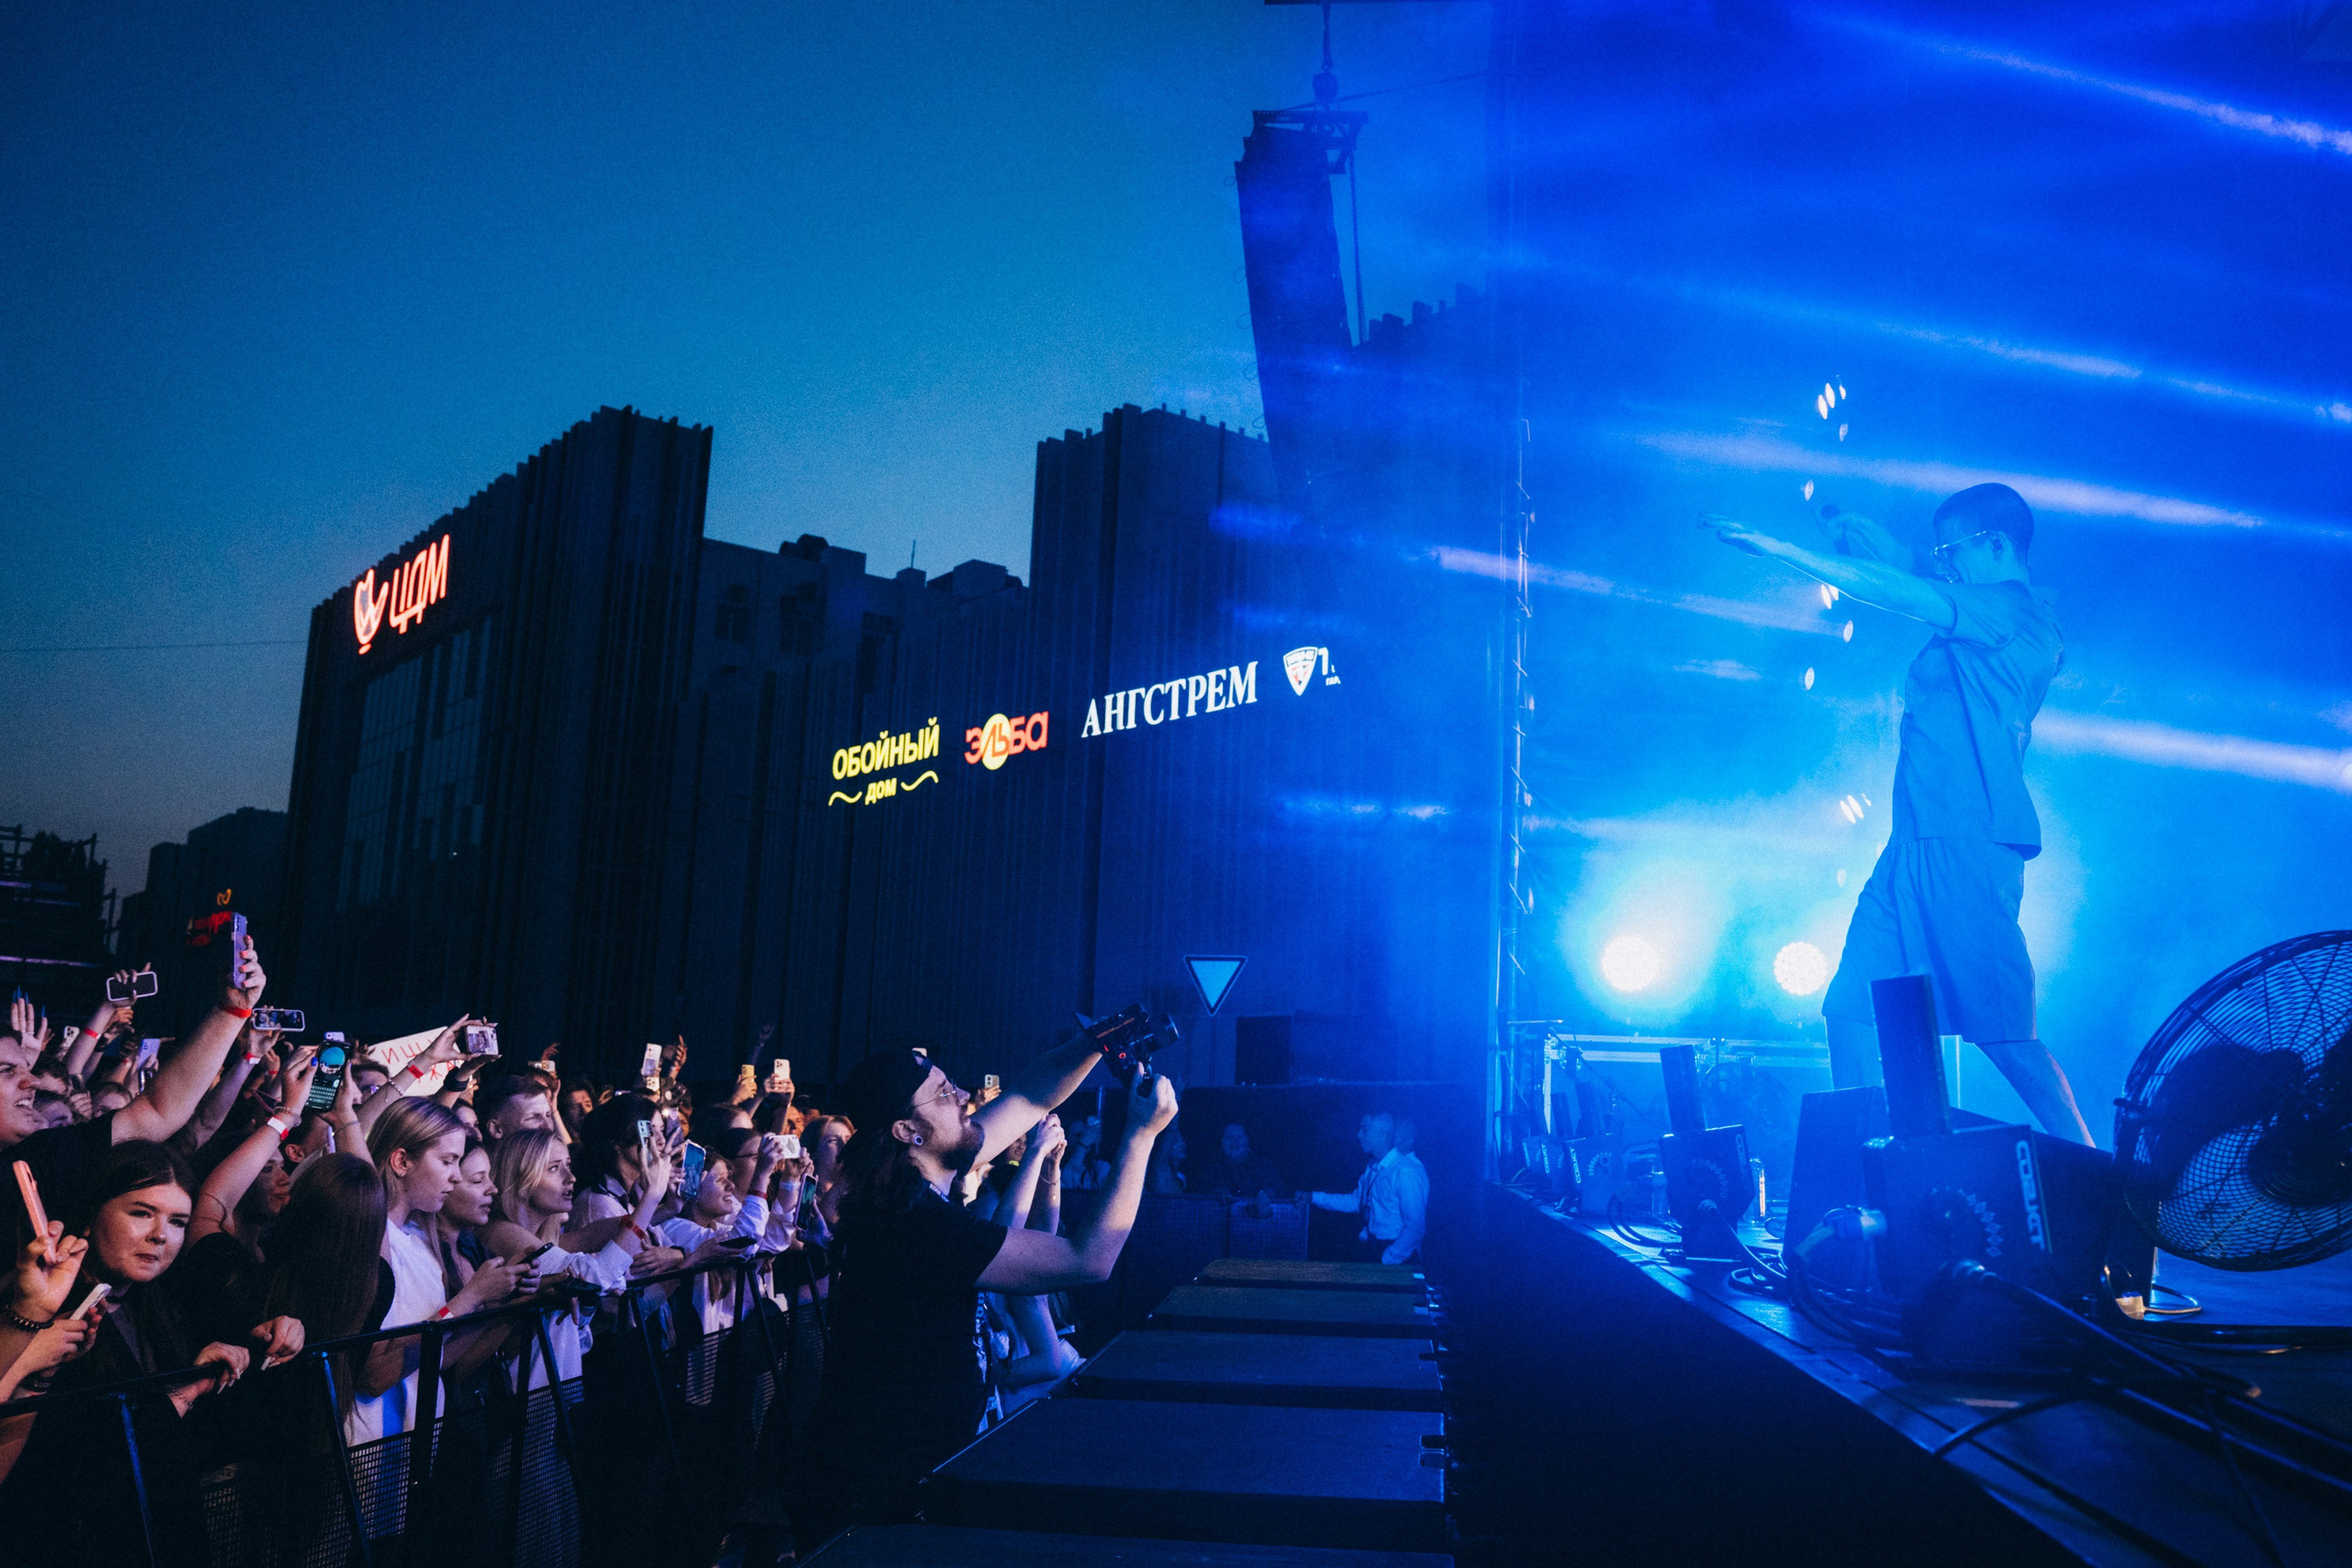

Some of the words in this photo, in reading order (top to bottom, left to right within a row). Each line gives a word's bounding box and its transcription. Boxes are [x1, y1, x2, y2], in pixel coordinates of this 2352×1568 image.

[390, 534, 450, 634] ЦДМ
[1080, 660, 1259, 739] АНГСТРЕМ
[831, 716, 940, 780] ОБОЙНЫЙ
[864, 778, 898, 806] ДОМ
